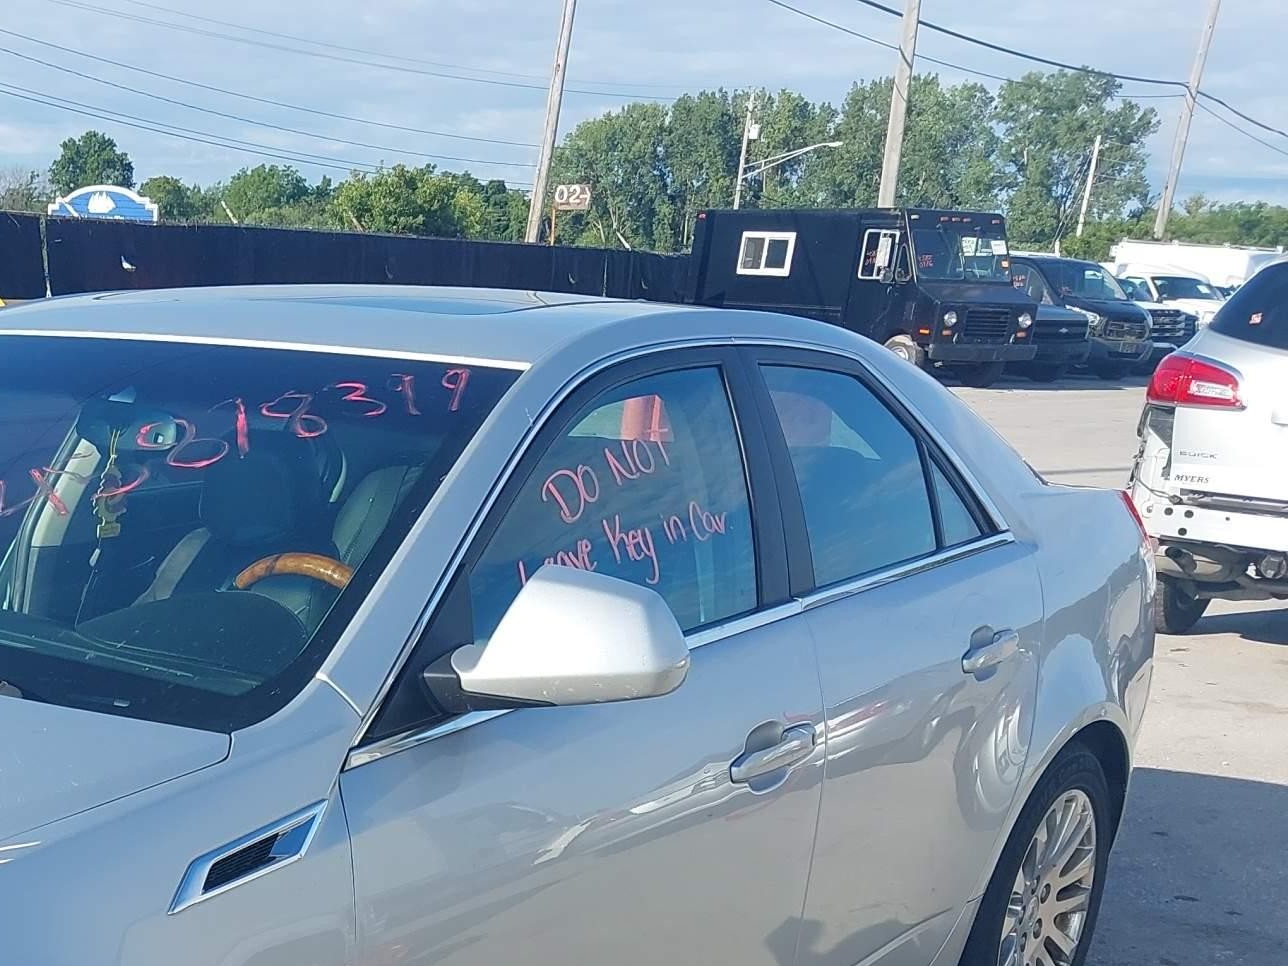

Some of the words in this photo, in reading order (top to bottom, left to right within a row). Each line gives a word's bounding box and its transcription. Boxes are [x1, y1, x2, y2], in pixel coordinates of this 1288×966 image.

[1179, 450, 1218, 460] BUICK
[541, 463, 600, 525] DO
[604, 425, 671, 487] NOT
[1174, 473, 1210, 485] MYERS
[660, 514, 688, 545] in
